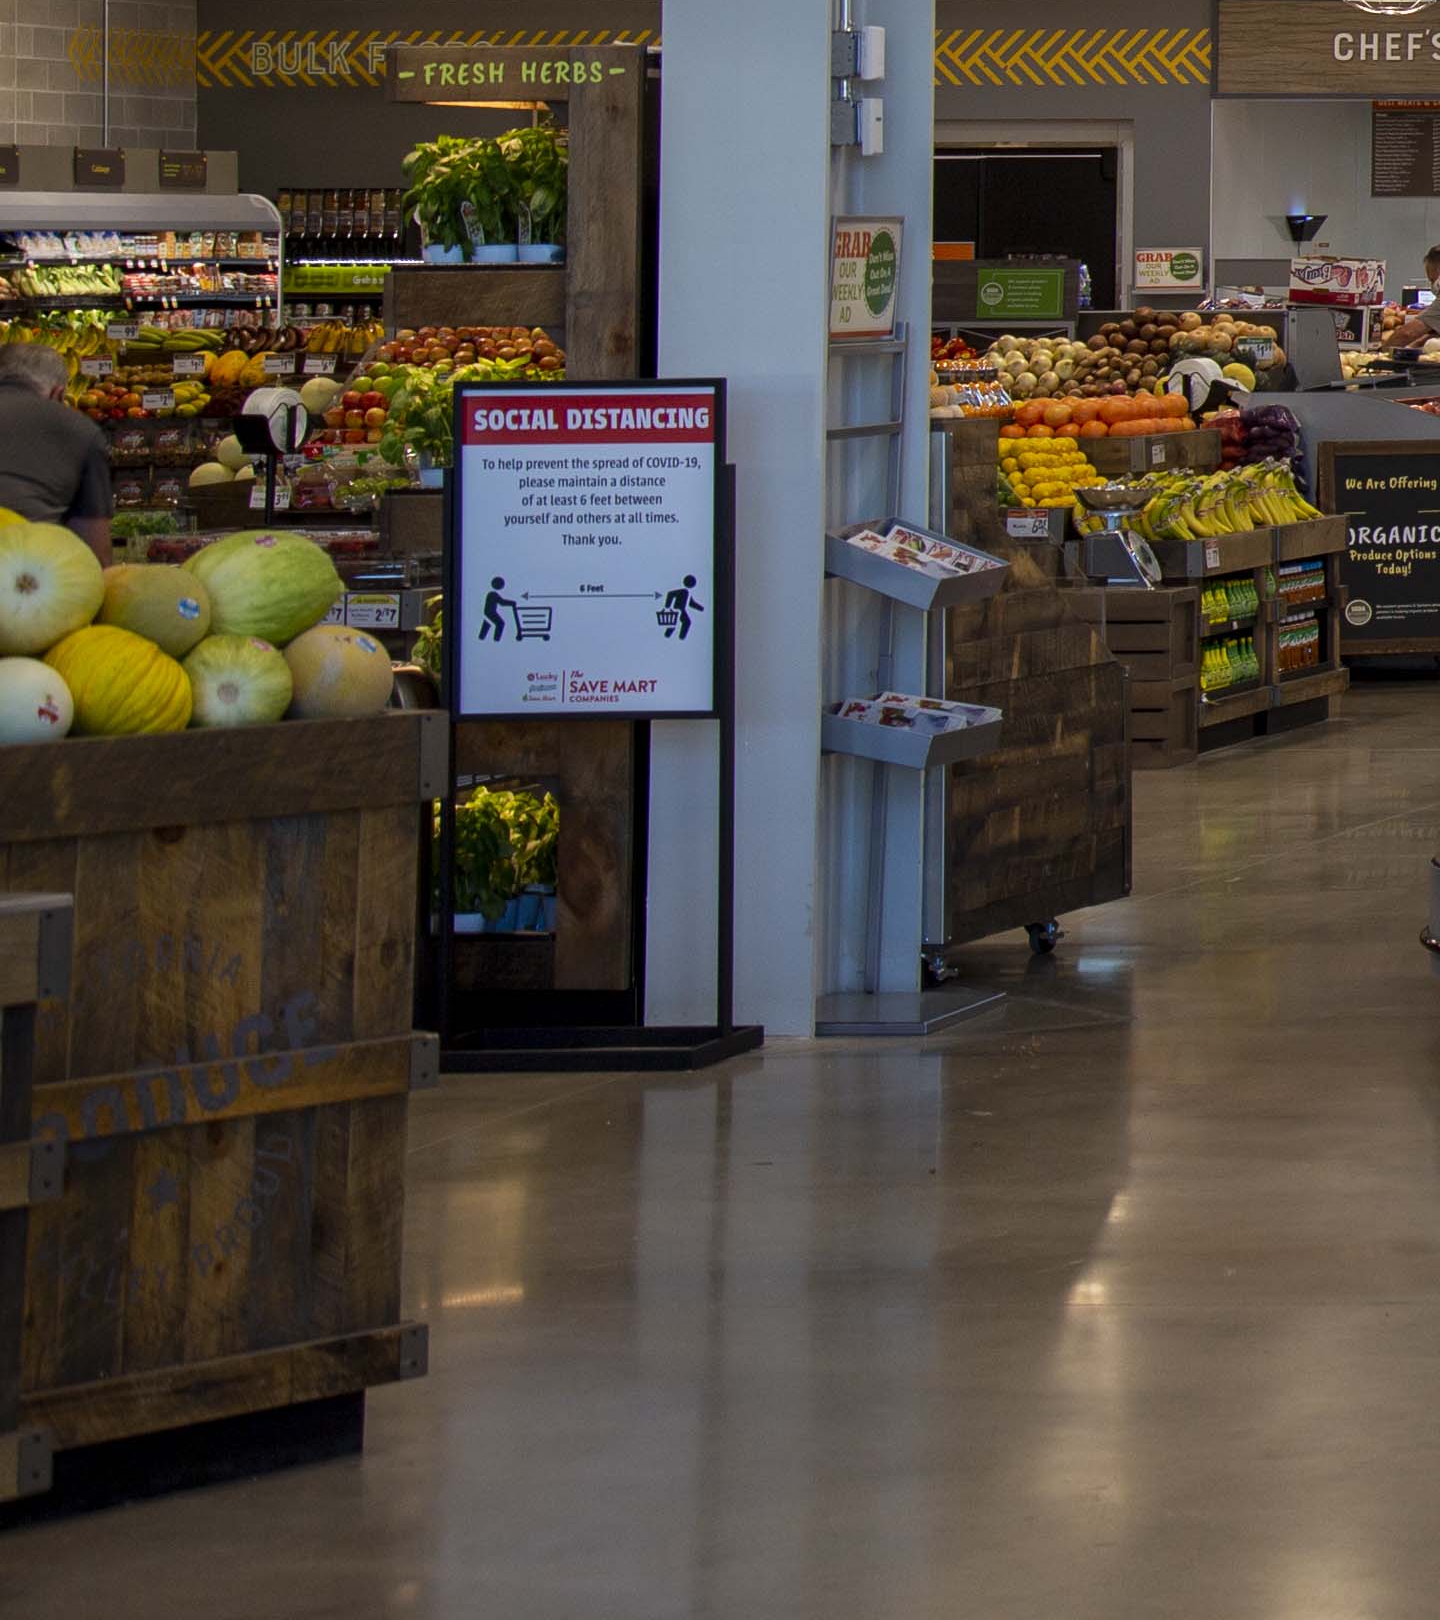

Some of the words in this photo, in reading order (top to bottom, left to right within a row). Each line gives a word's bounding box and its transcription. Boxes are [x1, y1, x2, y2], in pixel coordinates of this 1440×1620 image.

[251, 41, 351, 75] BULK
[423, 62, 504, 86] FRESH
[521, 61, 604, 85] HERBS
[474, 409, 558, 430] SOCIAL
[567, 408, 709, 429] DISTANCING
[482, 458, 495, 469] To
[498, 458, 523, 470] help
[525, 458, 569, 470] prevent
[572, 457, 590, 469] the
[592, 457, 629, 470] spread
[632, 457, 644, 469] of
[646, 457, 701, 469] COVID-19,
[519, 476, 555, 489] please
[558, 476, 608, 488] maintain
[610, 478, 617, 487] a
[620, 476, 665, 487] distance
[1346, 478, 1362, 490] We
[1366, 477, 1386, 490] Are
[1389, 476, 1437, 491] Offering
[522, 494, 534, 506] of
[536, 495, 547, 506] at
[550, 494, 577, 506] least
[580, 495, 587, 505] 6
[590, 494, 612, 505] feet
[614, 494, 662, 506] between
[504, 513, 550, 526] yourself
[553, 513, 573, 524] and
[576, 513, 611, 524] others
[614, 513, 625, 524] at
[628, 512, 643, 523] all
[646, 512, 679, 523] times.
[562, 535, 595, 546] Thank
[598, 535, 622, 547] you.
[1350, 549, 1392, 561] Produce
[1396, 549, 1436, 562] Options
[1376, 562, 1412, 576] Today!
[570, 681, 608, 692] SAVE
[613, 680, 657, 692] MART
